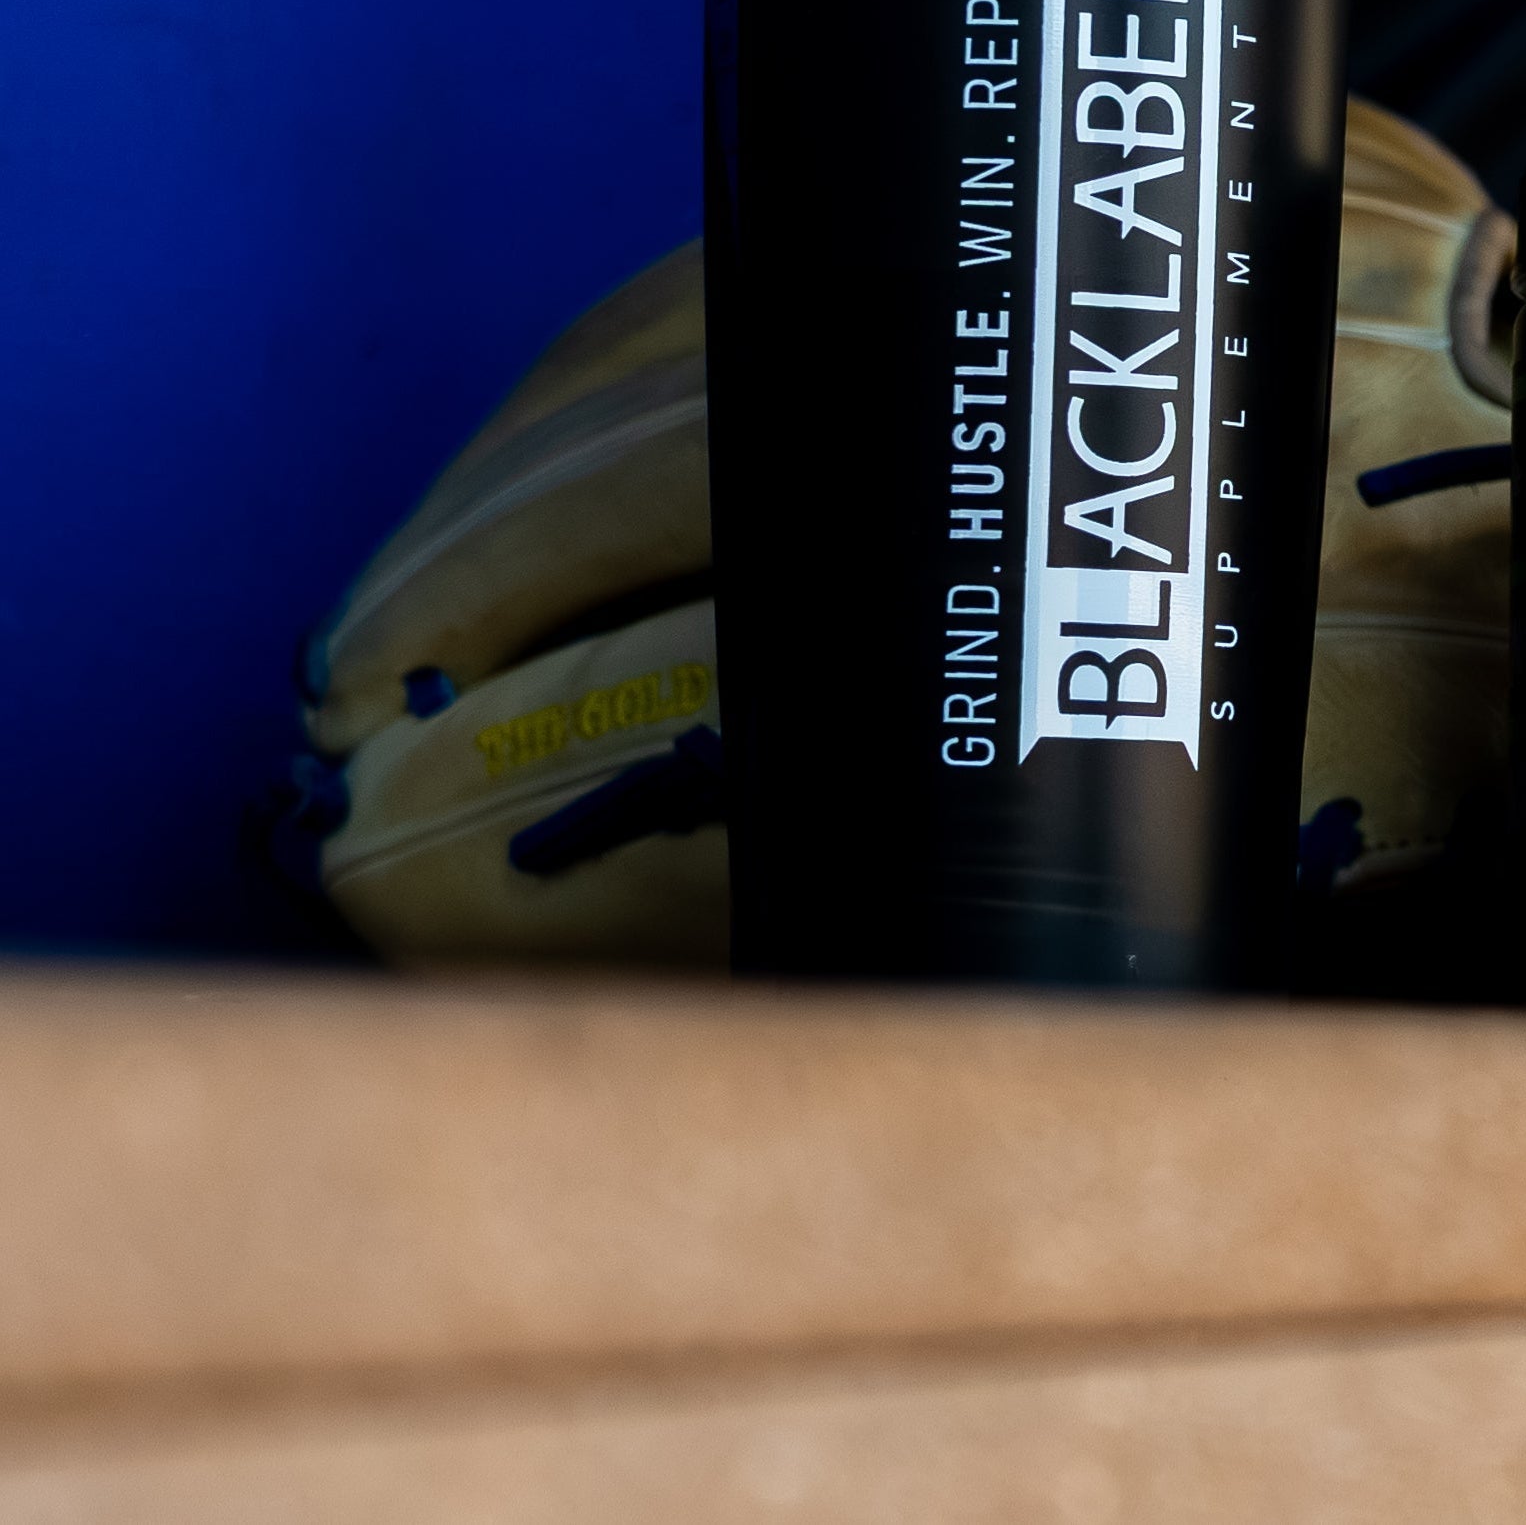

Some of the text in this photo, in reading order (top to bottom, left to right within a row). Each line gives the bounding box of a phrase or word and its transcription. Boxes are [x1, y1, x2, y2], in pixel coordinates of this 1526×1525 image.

[958, 134, 1016, 268] WIN.
[949, 291, 1011, 540] HUSTLE.
[941, 565, 1001, 768] GRIND.
